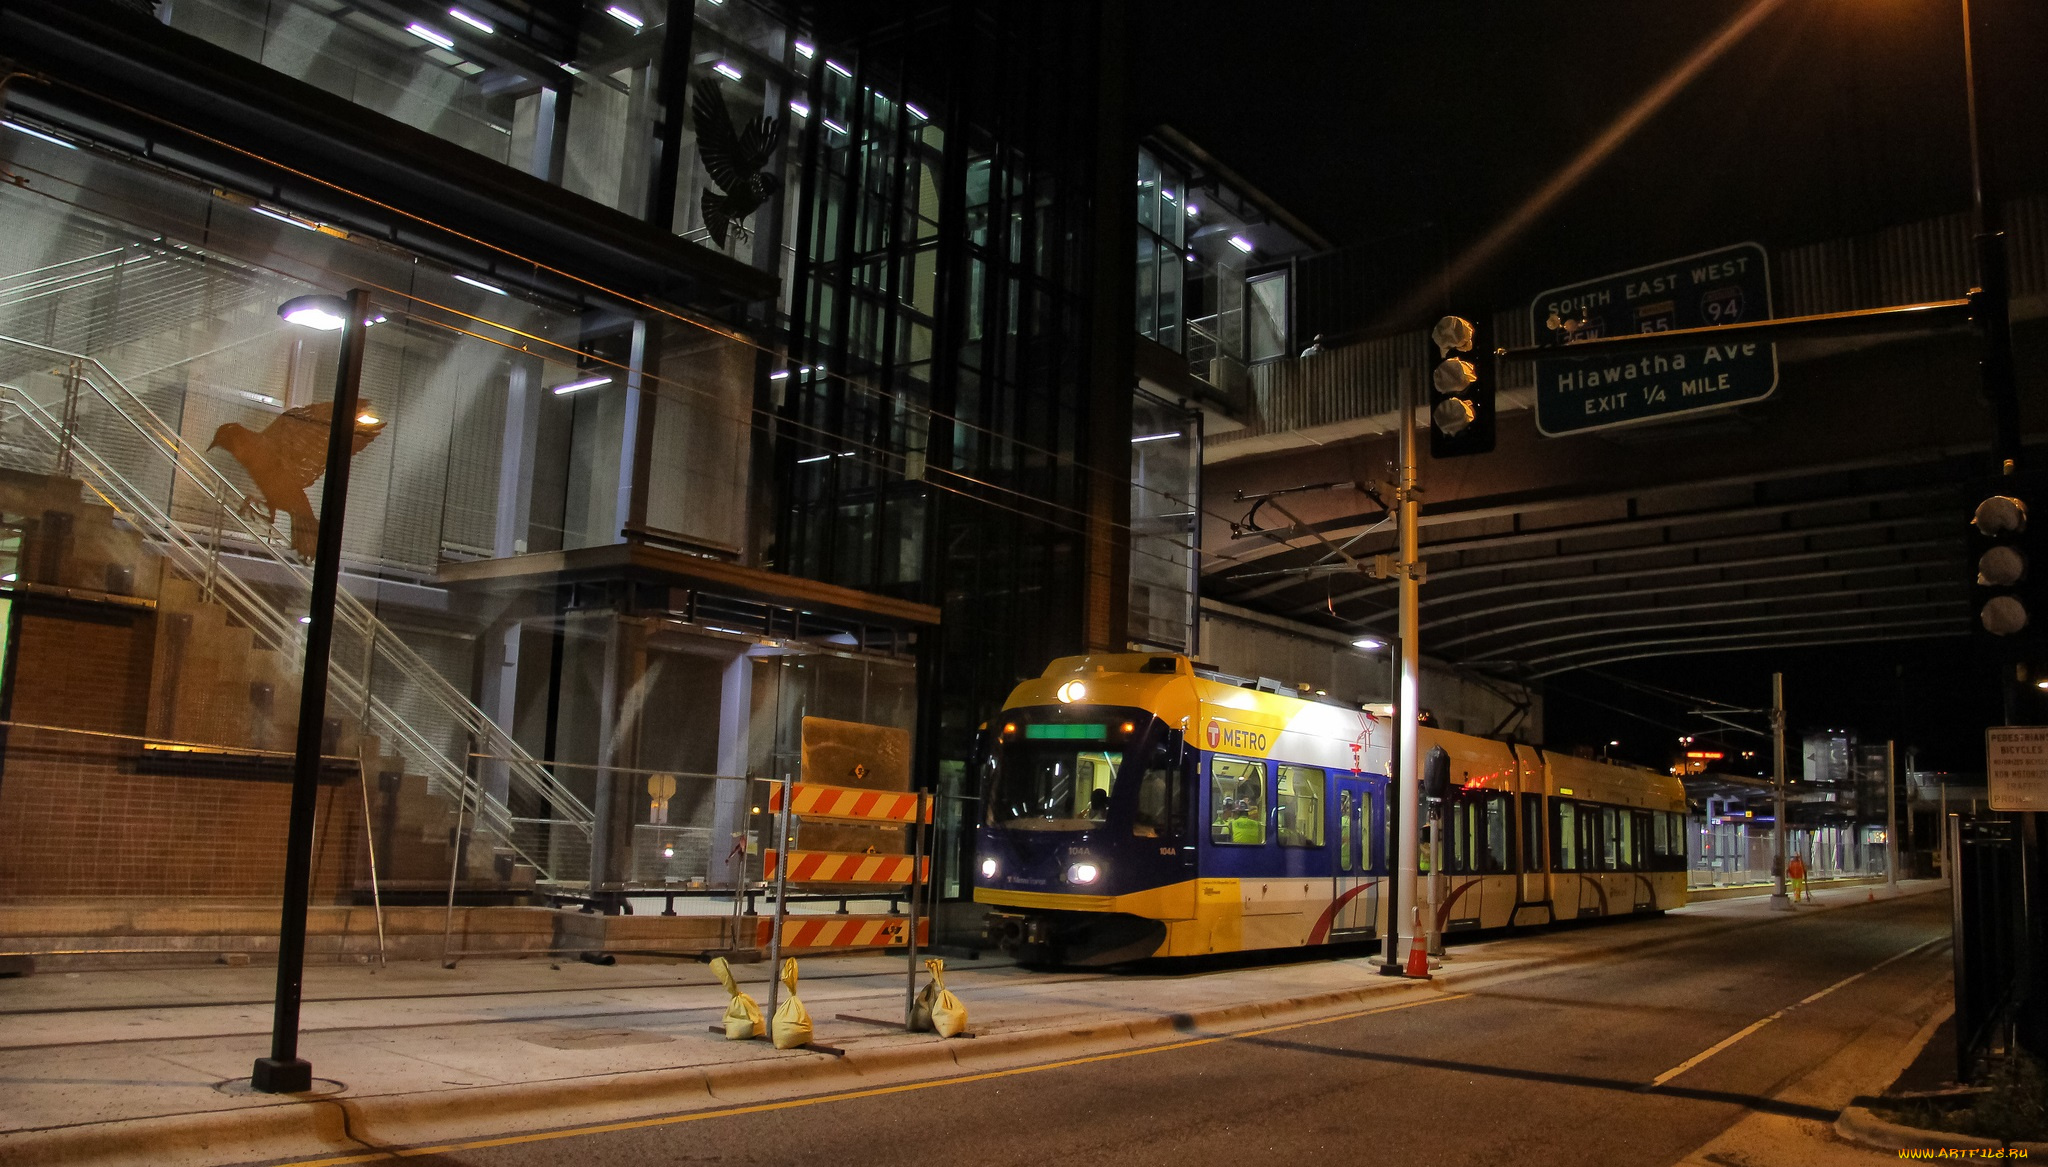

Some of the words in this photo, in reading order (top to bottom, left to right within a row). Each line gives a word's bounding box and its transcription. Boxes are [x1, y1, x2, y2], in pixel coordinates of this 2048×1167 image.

[1548, 290, 1611, 316] SOUTH
[1625, 274, 1677, 300] EAST
[1691, 257, 1748, 284] WEST
[1708, 299, 1738, 321] 94
[1558, 354, 1686, 393] Hiawatha
[1703, 343, 1757, 365] Ave
[1585, 392, 1628, 415] EXIT
[1681, 373, 1731, 397] MILE
[1223, 727, 1267, 751] METRO
[2000, 746, 2043, 755] BICYCLES
[1068, 846, 1091, 856] 104A
[1160, 847, 1177, 856] 104A
